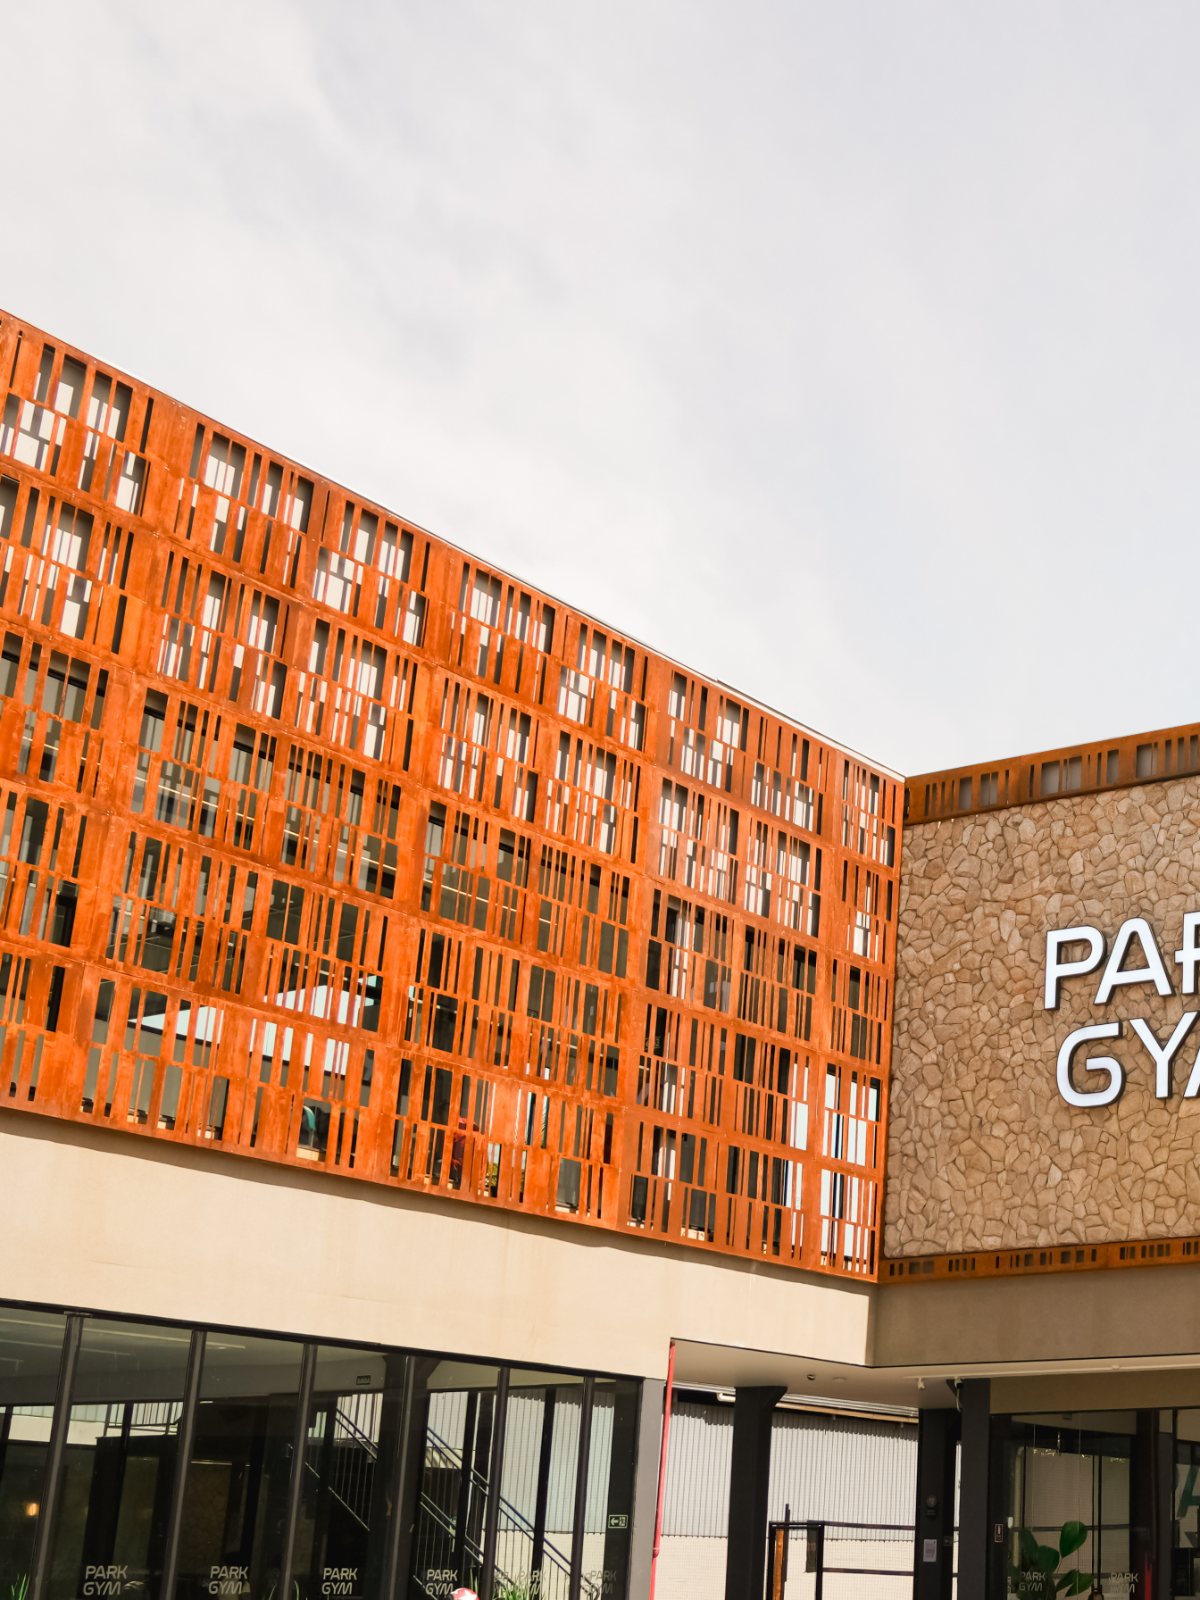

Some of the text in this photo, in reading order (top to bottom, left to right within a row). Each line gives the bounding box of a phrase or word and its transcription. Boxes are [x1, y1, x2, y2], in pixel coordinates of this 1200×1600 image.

[84, 1565, 129, 1580] PARK
[209, 1566, 249, 1580] PARK
[322, 1567, 358, 1581] PARK
[426, 1569, 458, 1582] PARK
[591, 1570, 617, 1582] PARK
[1020, 1571, 1046, 1582] PARK
[82, 1581, 121, 1596] GYM
[208, 1581, 243, 1595] GYM
[321, 1582, 353, 1596] GYM
[425, 1583, 454, 1596] GYM
[1019, 1582, 1043, 1592] GYM
